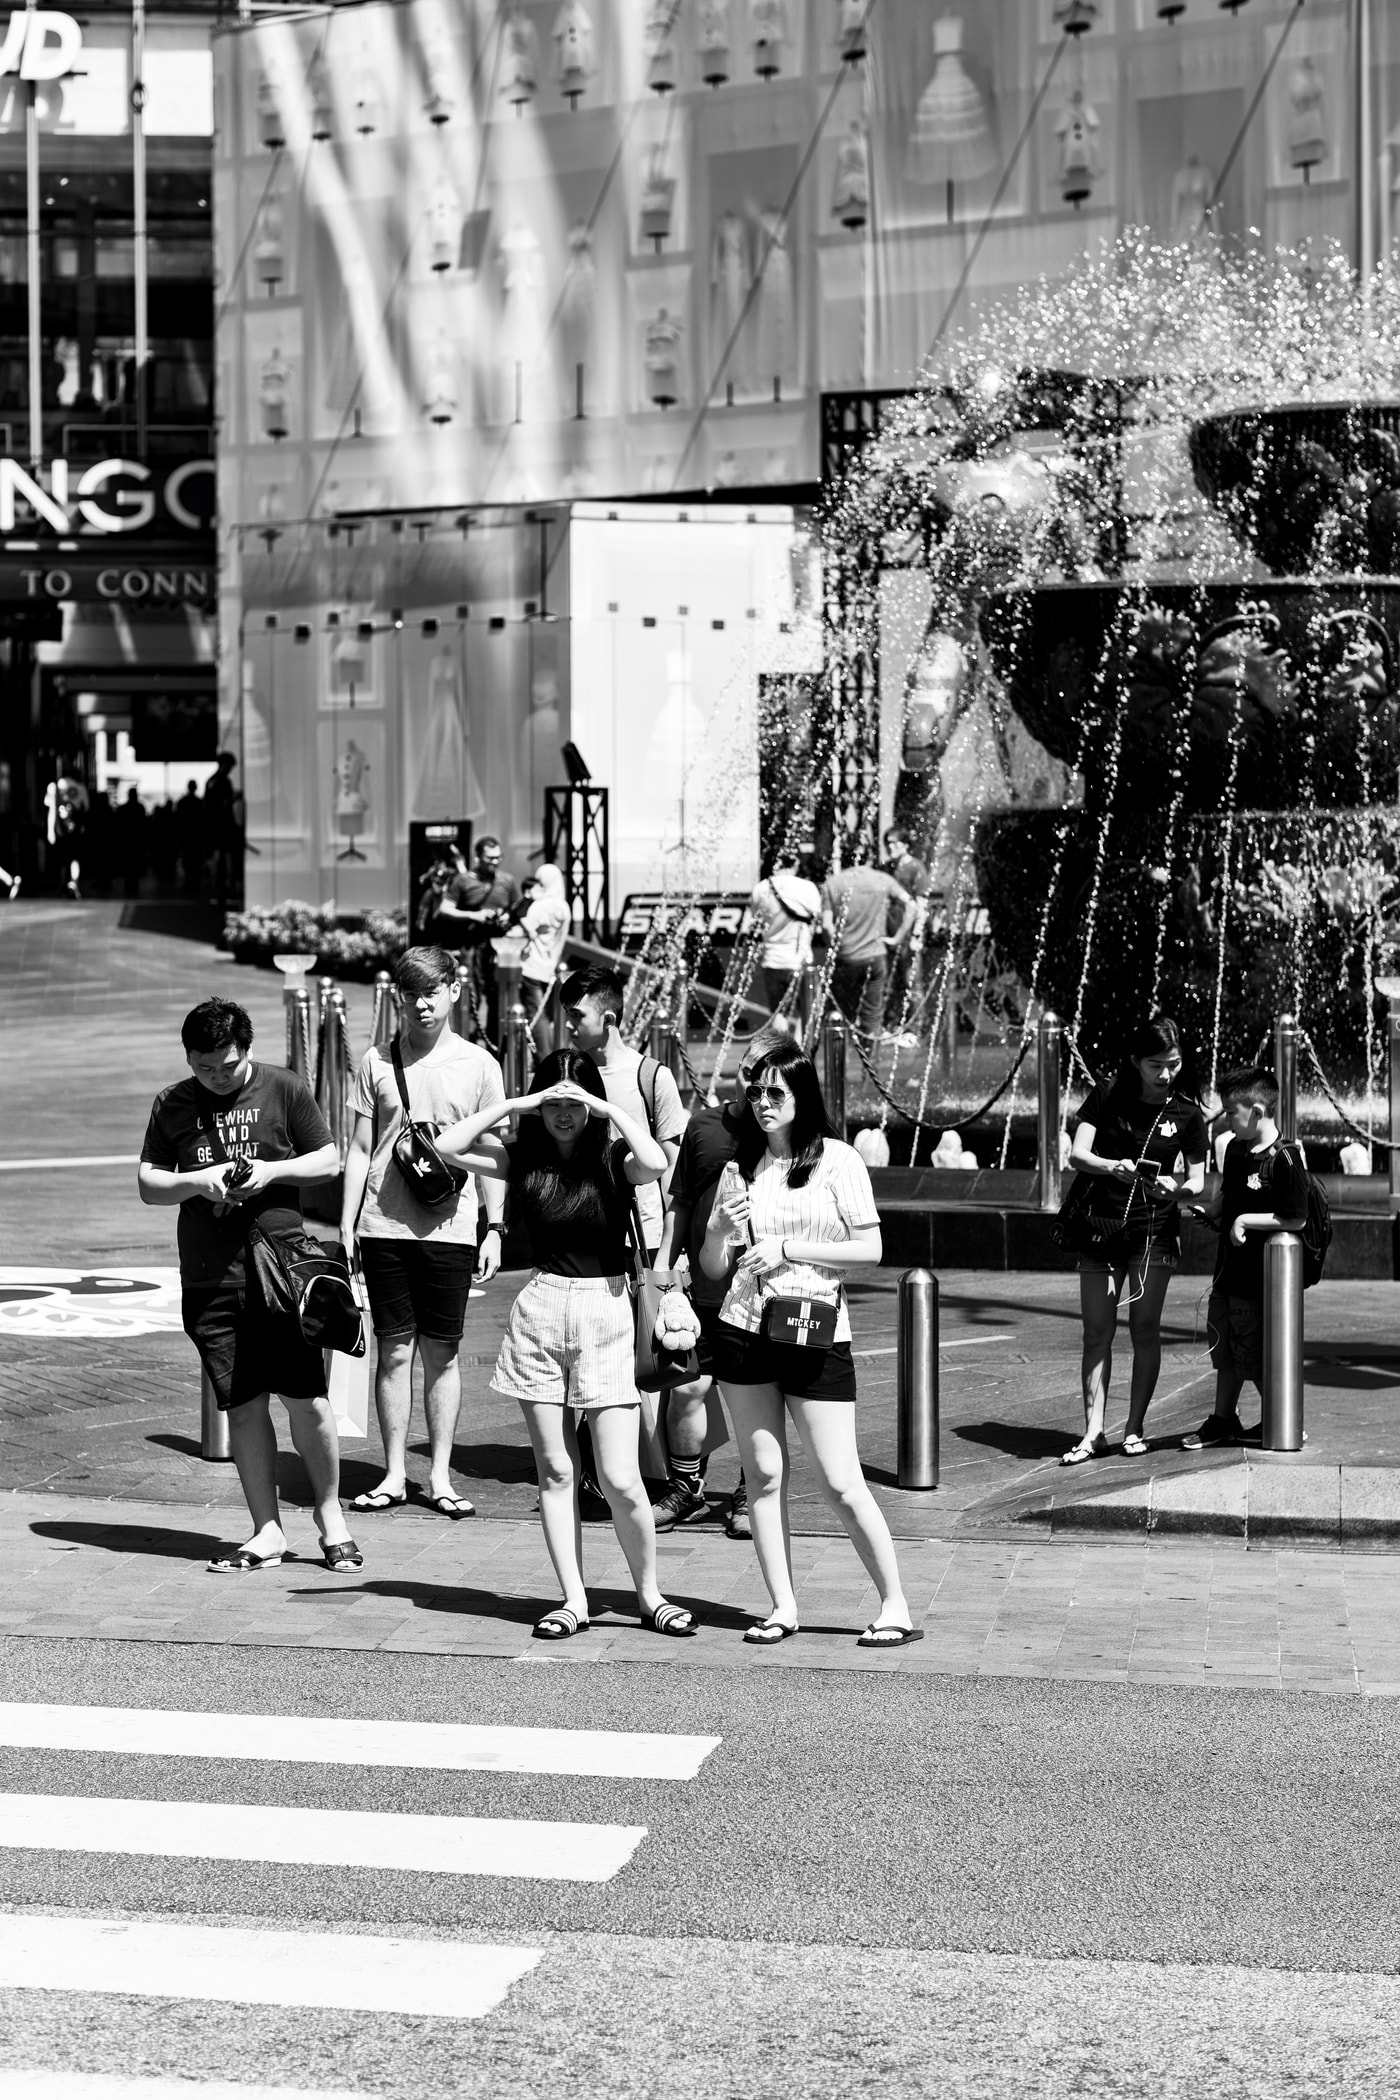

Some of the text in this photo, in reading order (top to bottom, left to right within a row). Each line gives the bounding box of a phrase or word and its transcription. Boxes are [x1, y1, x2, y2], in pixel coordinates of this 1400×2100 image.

[20, 568, 72, 598] TO
[225, 1108, 260, 1126] WHAT
[224, 1142, 259, 1159] WHAT
[786, 1317, 821, 1330] MICKEY
